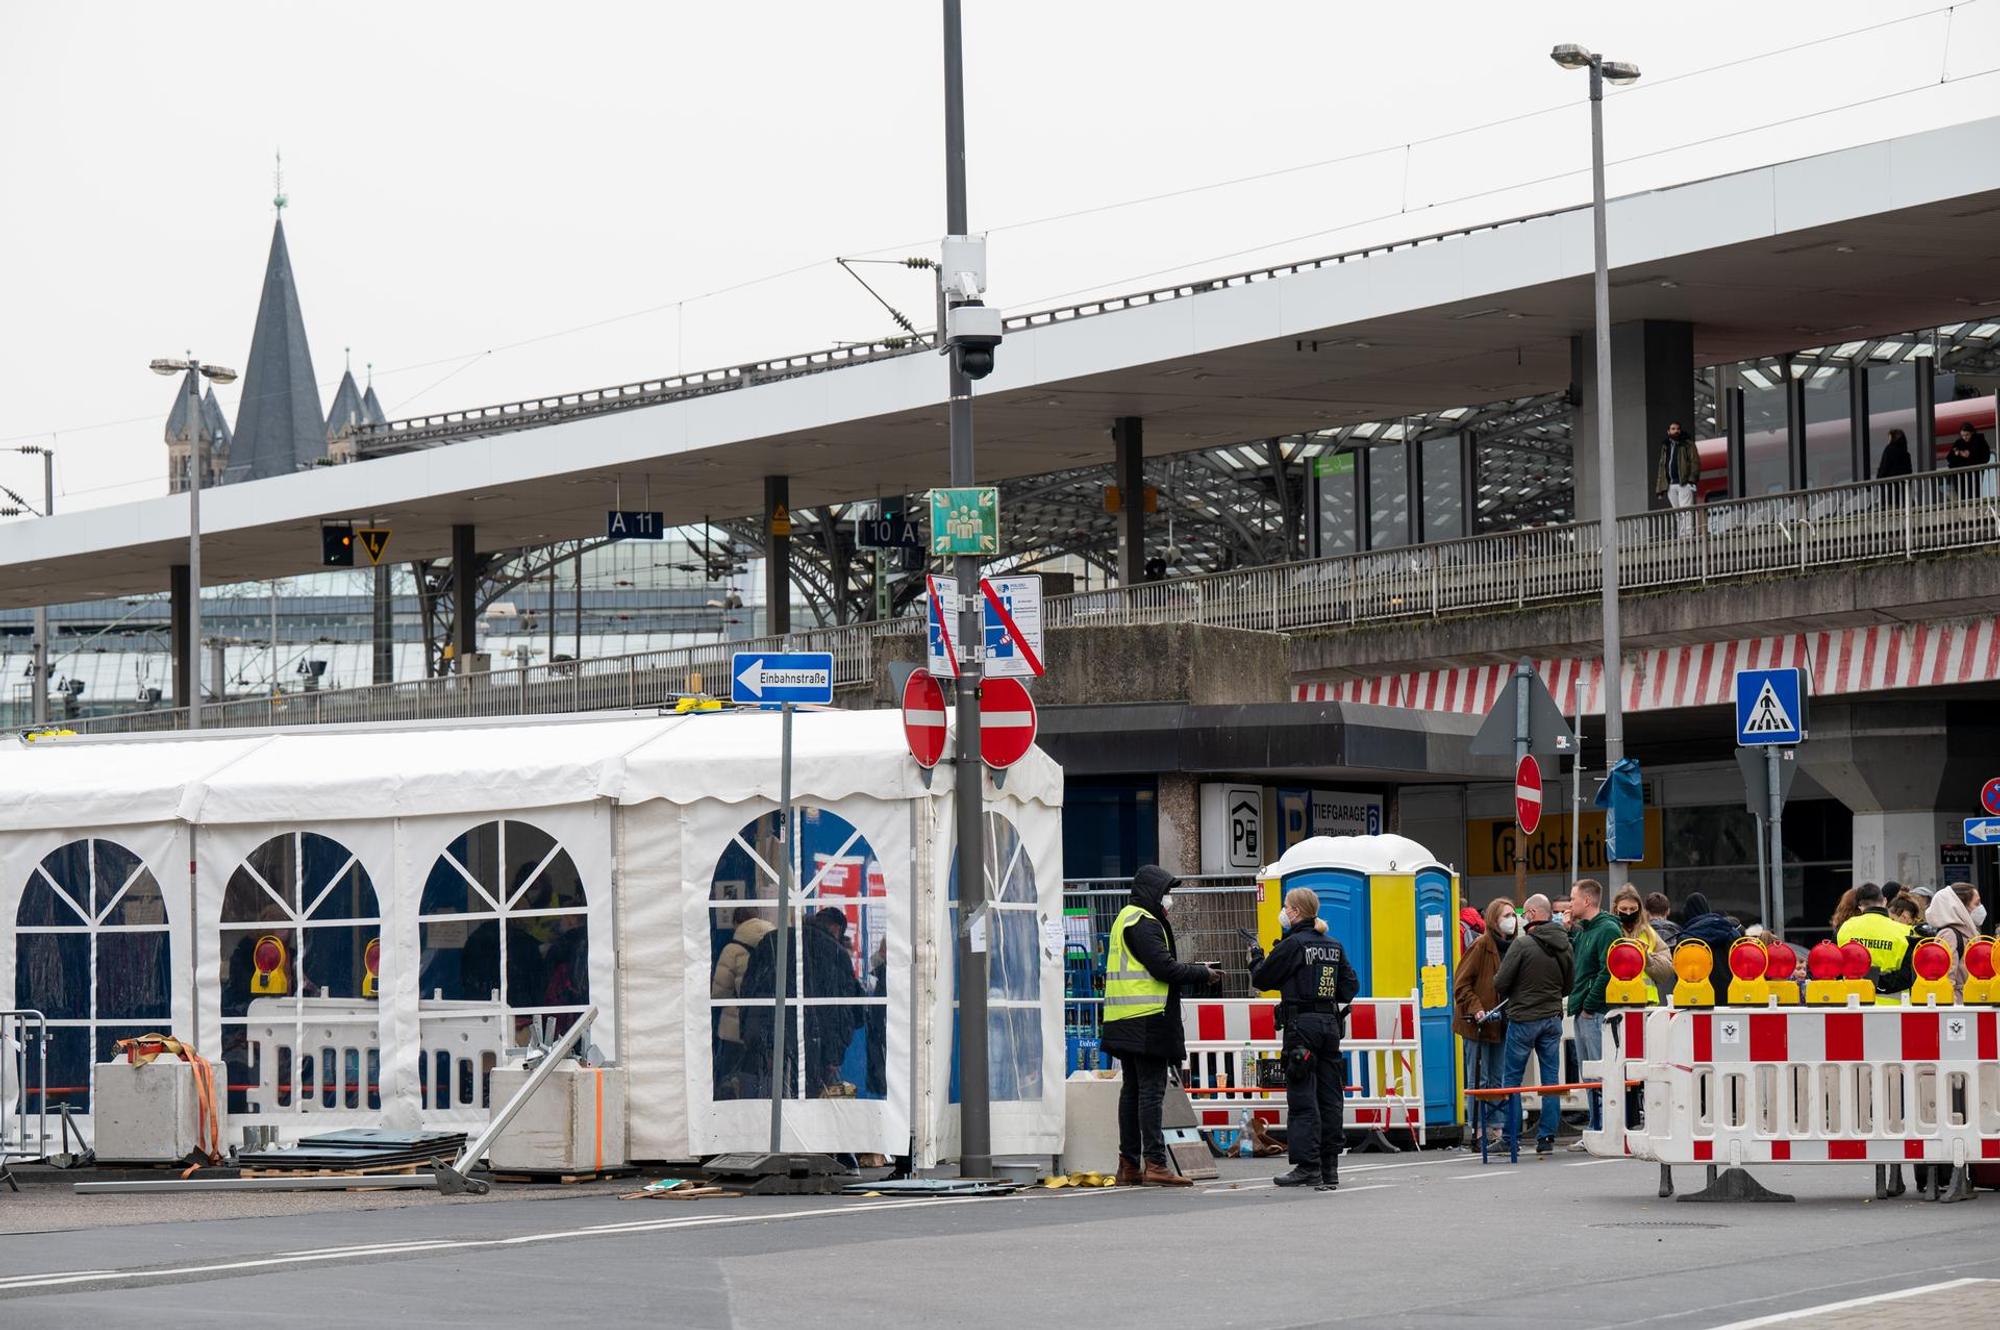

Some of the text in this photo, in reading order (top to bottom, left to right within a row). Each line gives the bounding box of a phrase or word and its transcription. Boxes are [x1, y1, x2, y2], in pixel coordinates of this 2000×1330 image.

[611, 512, 653, 533] A 11
[870, 521, 916, 543] 10 A
[760, 672, 826, 684] Einbahnstraße
[1313, 803, 1365, 822] TIEFGARAGE
[1312, 946, 1340, 962] POLIZE
[1322, 966, 1334, 976] BP
[1319, 976, 1335, 987] STA
